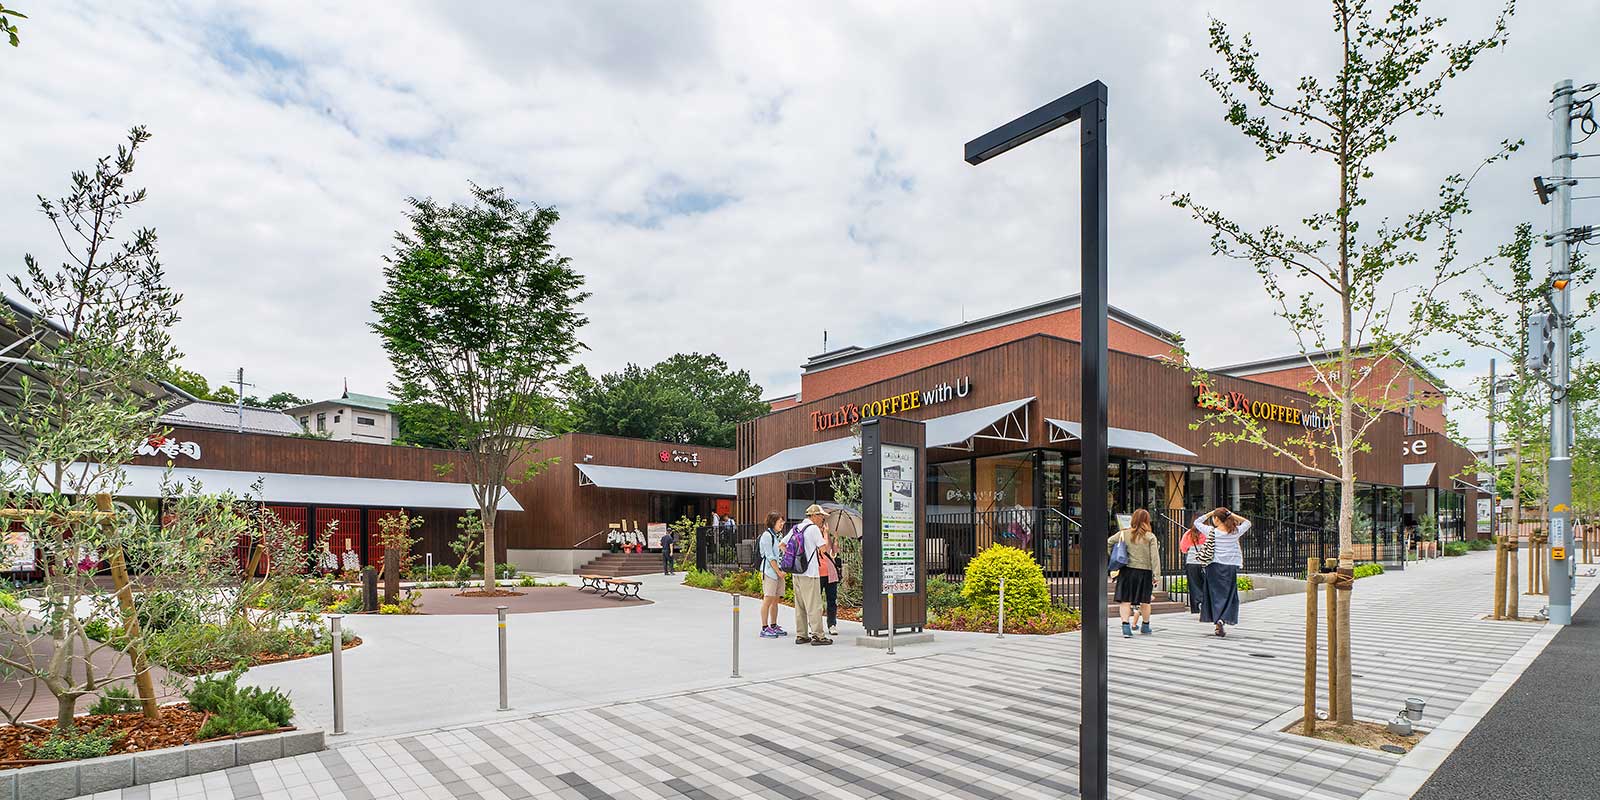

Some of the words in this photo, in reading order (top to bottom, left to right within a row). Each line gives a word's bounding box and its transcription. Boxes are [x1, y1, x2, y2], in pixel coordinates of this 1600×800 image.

[1312, 366, 1372, 385] 大和学
[861, 390, 920, 419] COFFEE
[923, 382, 952, 406] with
[957, 376, 970, 397] U
[1251, 400, 1300, 425] COFFEE
[1301, 410, 1321, 429] with
